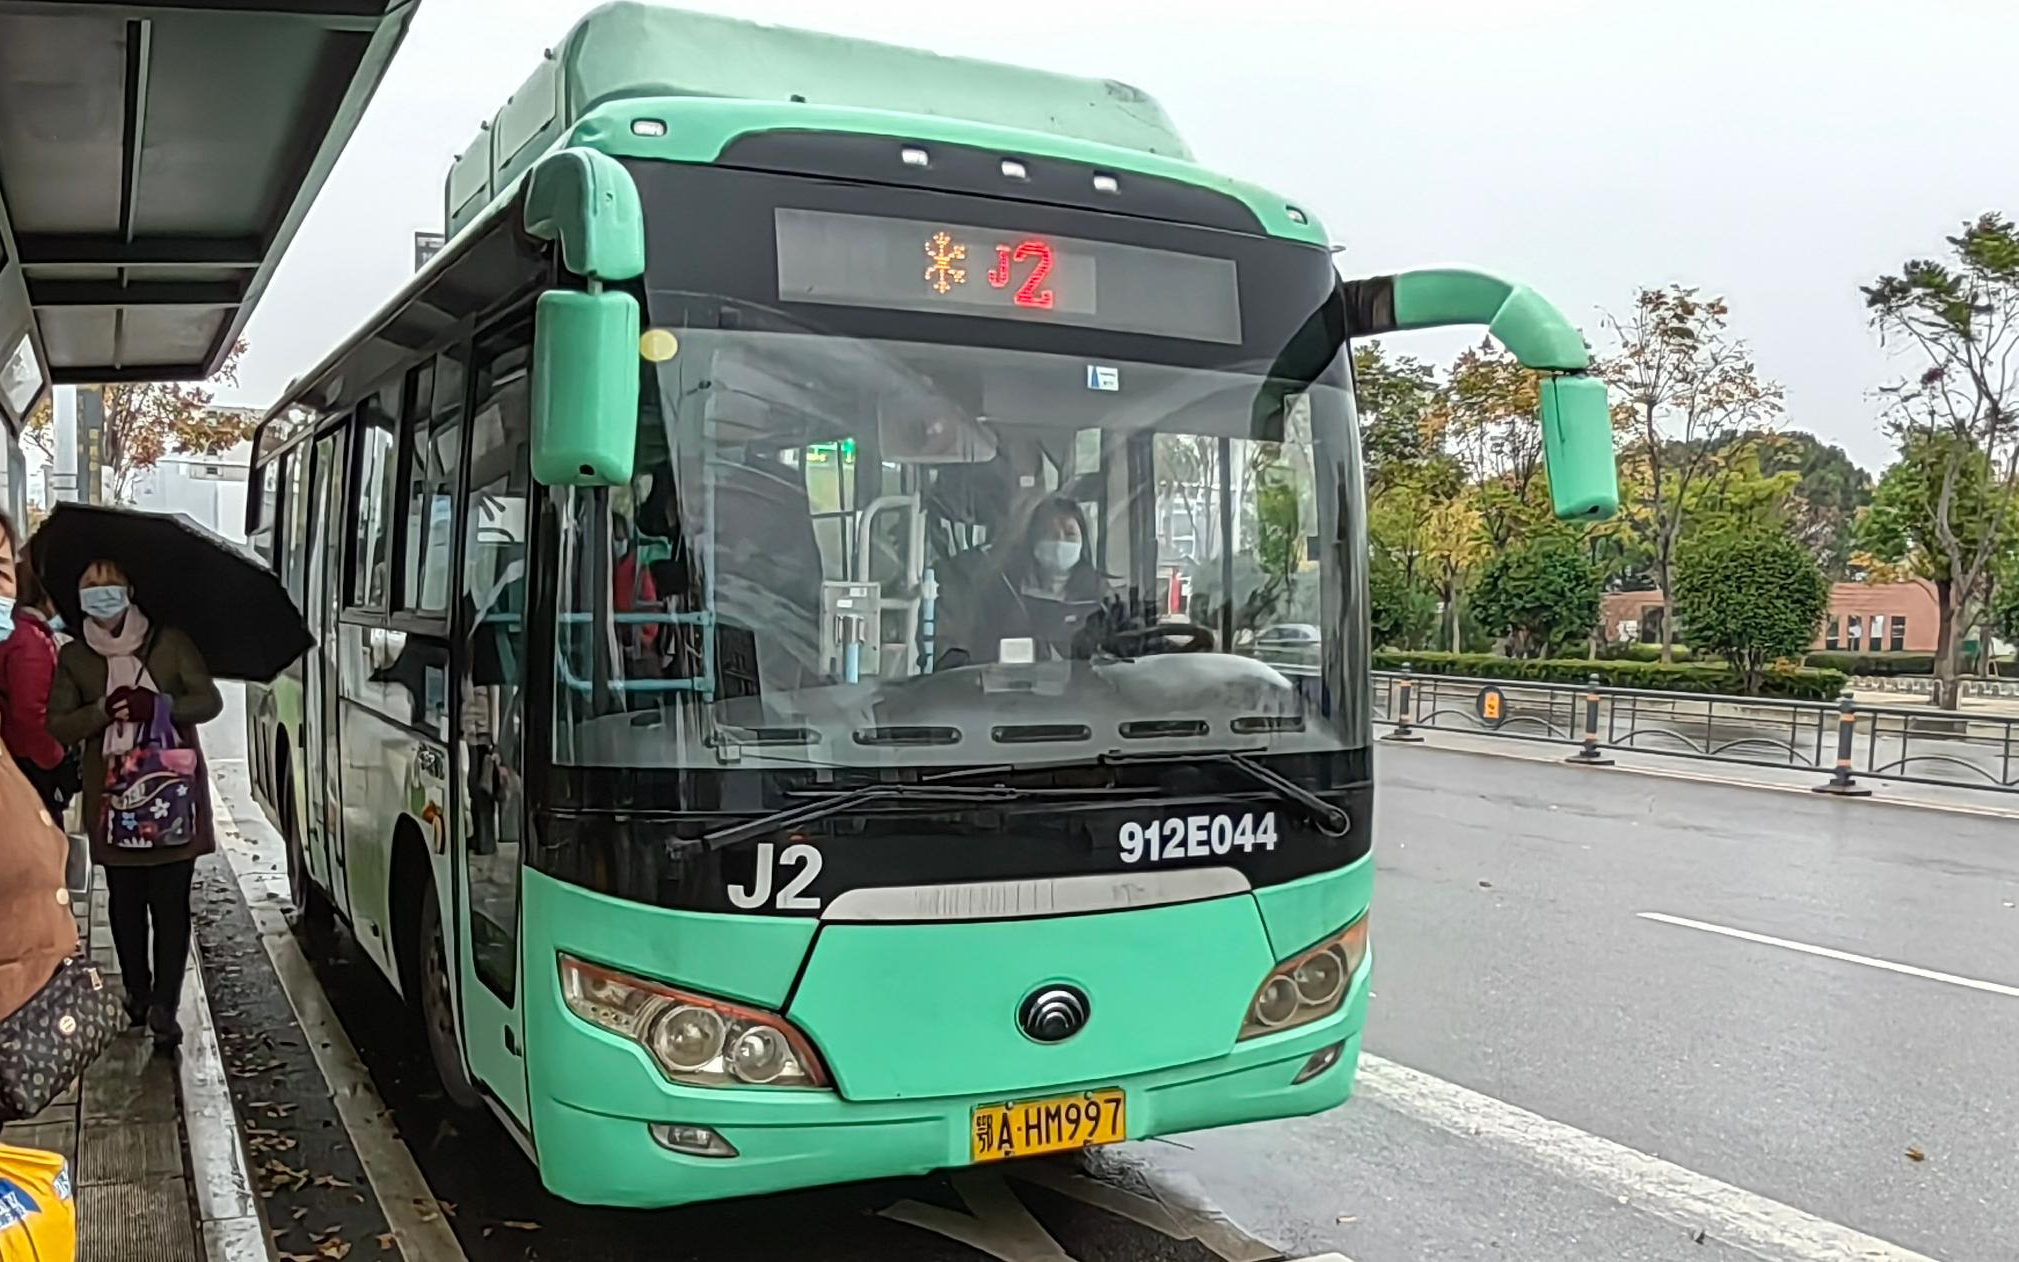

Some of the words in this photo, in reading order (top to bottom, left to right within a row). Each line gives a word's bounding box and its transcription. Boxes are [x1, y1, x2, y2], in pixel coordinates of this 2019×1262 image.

[987, 242, 1054, 309] J2
[1119, 811, 1278, 863] 912E044
[727, 843, 823, 909] J2
